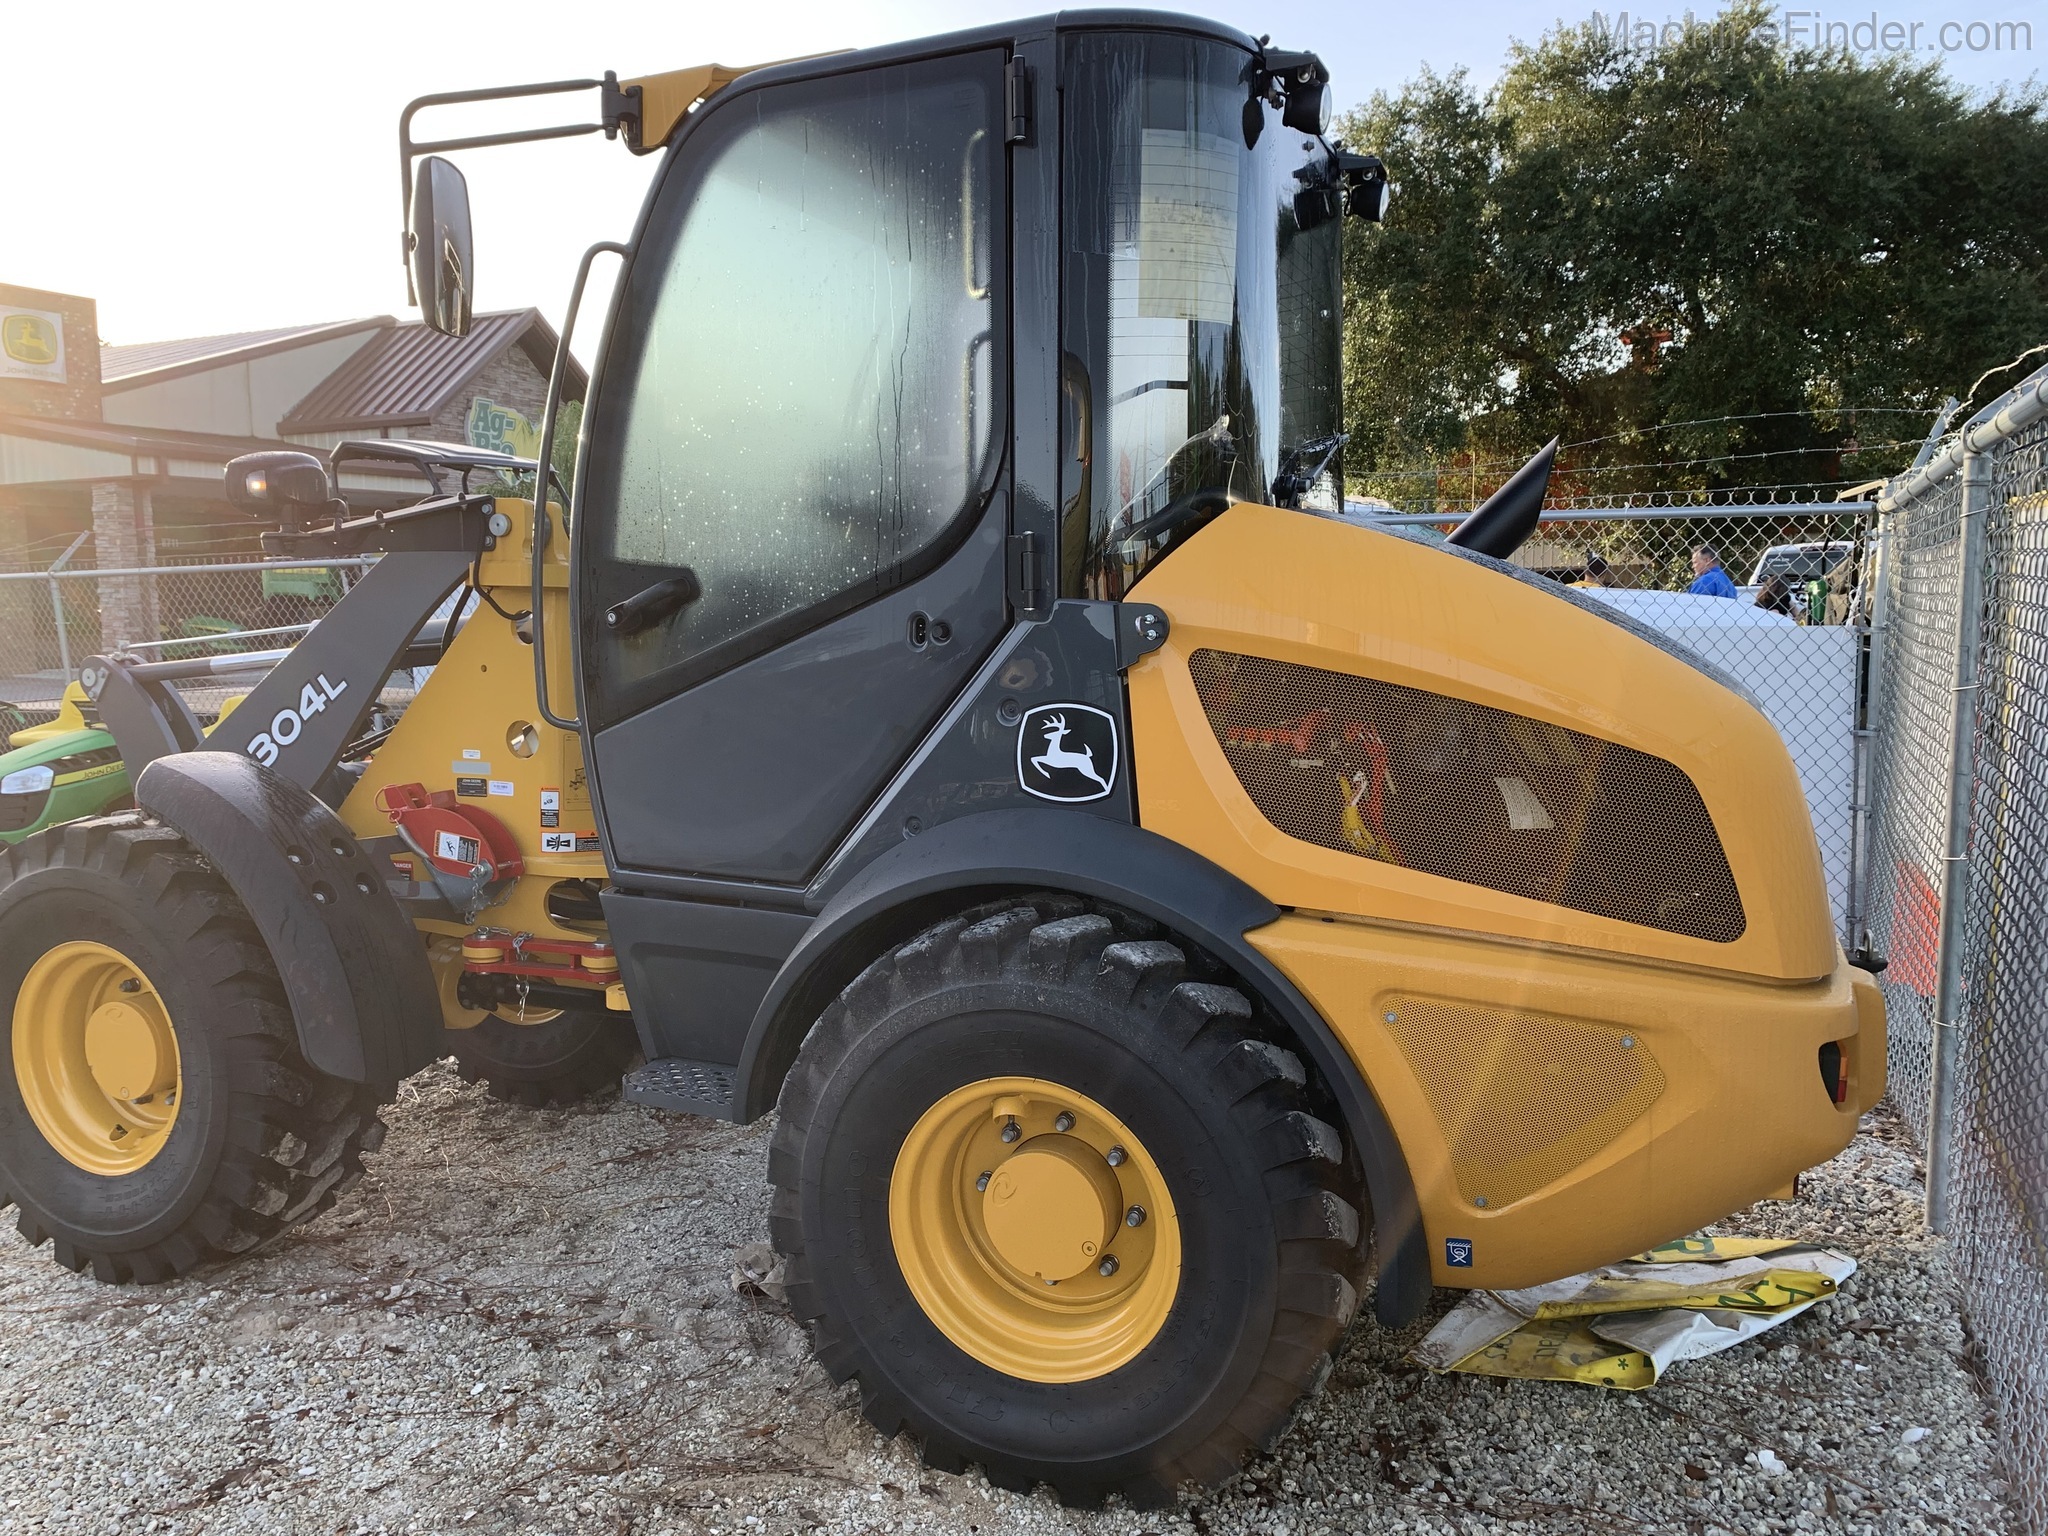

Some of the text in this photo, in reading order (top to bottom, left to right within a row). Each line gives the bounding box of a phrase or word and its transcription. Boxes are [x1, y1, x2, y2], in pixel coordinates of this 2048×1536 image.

[5, 366, 31, 375] JOHN
[473, 401, 514, 440] Ag-
[246, 673, 348, 768] 304L
[82, 762, 125, 779] JOHN DEER
